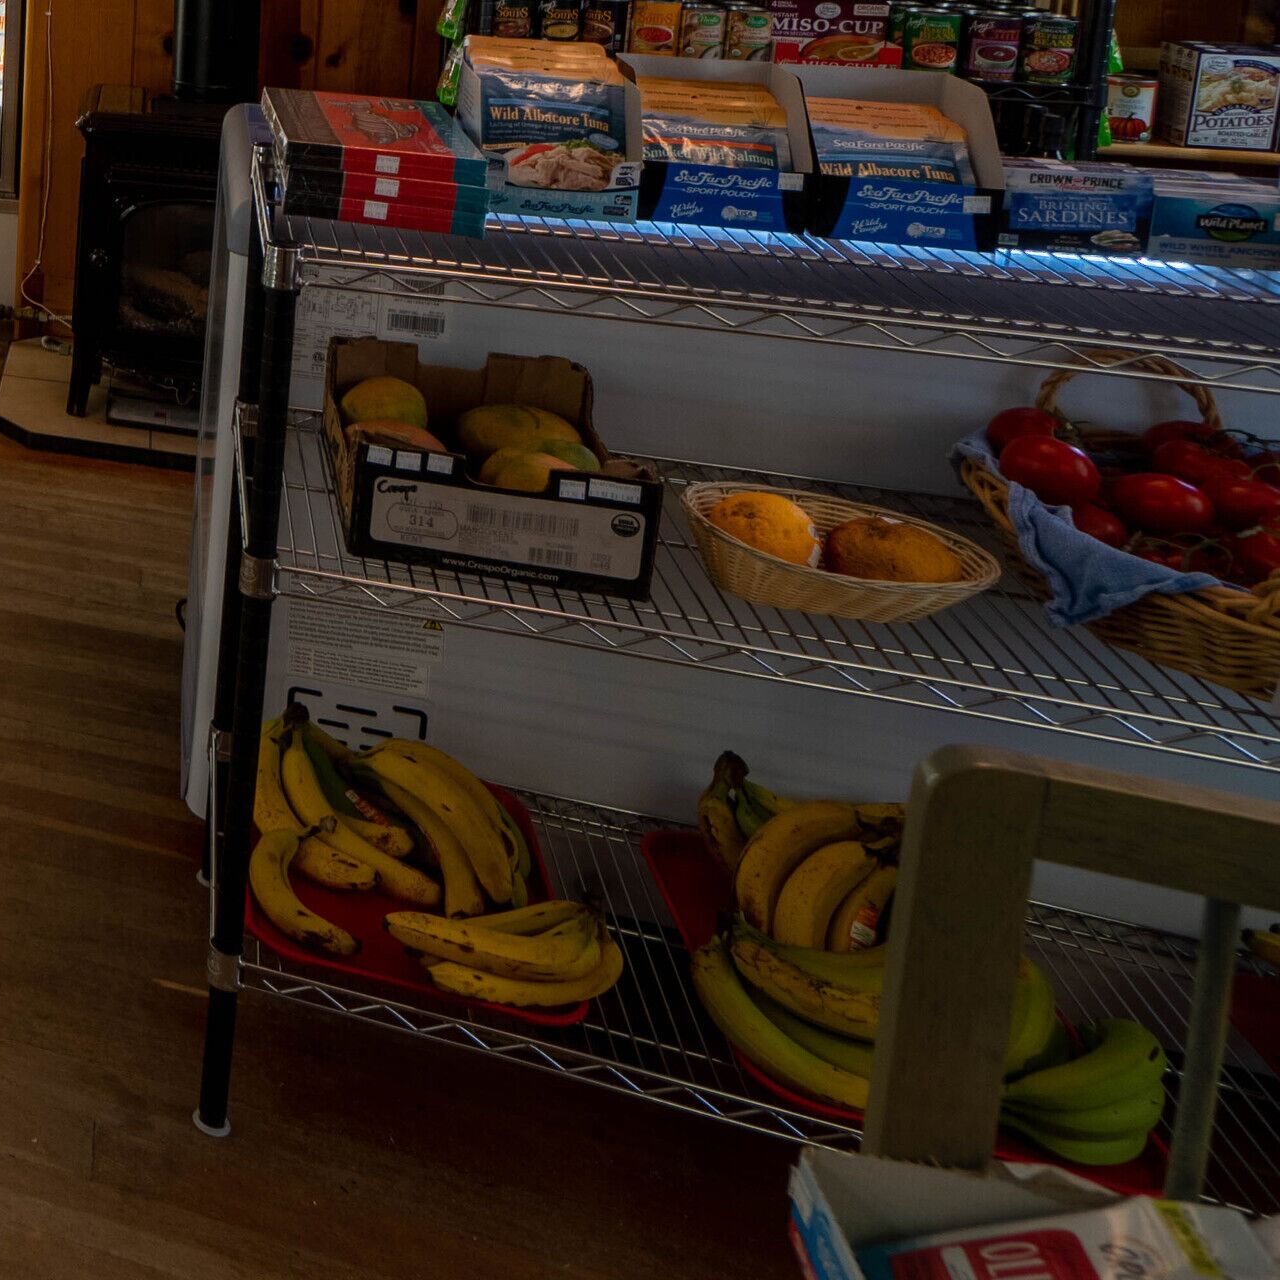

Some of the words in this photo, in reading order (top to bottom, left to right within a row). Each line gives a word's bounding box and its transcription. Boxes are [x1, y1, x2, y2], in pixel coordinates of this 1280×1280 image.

[773, 18, 884, 35] MISO-CUP
[489, 106, 518, 122] Wild
[523, 107, 580, 125] Albacore
[582, 114, 609, 132] Tuna
[1192, 114, 1274, 133] POTATOES
[729, 149, 775, 166] Salmon
[819, 162, 852, 177] Wild
[857, 162, 920, 179] Albacore
[921, 165, 956, 182] Tuna
[1029, 172, 1073, 185] CROWN
[1082, 176, 1125, 190] PRINCE
[685, 187, 718, 197] SPORT
[720, 189, 756, 199] POUCH
[869, 201, 904, 211] SPORT
[907, 205, 945, 216] POUCH
[1039, 200, 1108, 212] BRISLING
[1017, 208, 1128, 225] SARDINES
[1199, 216, 1230, 230] Wild
[1231, 217, 1266, 232] Planet
[1159, 241, 1187, 251] WILD
[1190, 243, 1226, 253] WHITE
[409, 514, 434, 529] 314
[441, 556, 559, 583] www.CrespoOrganic.com
